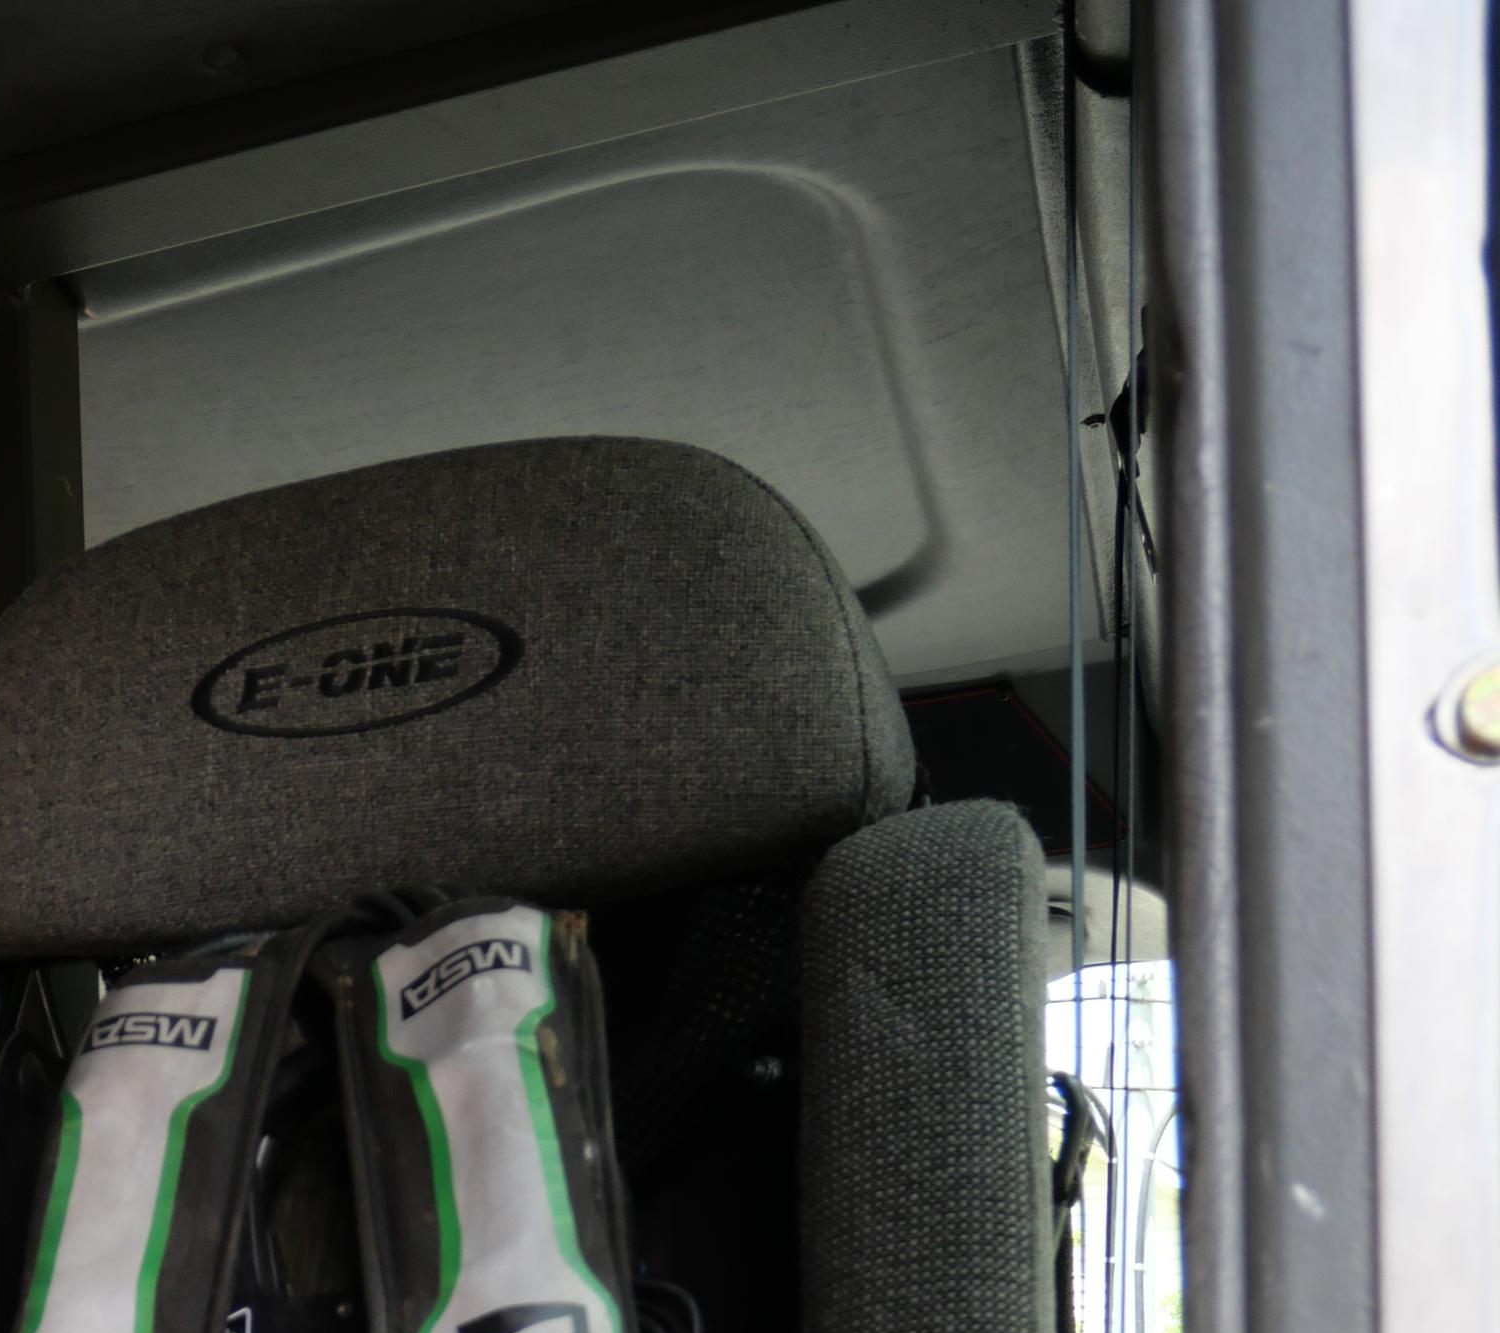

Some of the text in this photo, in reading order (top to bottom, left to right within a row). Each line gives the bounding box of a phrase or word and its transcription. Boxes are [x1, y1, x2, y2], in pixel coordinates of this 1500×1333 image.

[235, 631, 464, 716] E-ONE
[403, 940, 524, 1011] MSA
[90, 1014, 210, 1049] MSA
